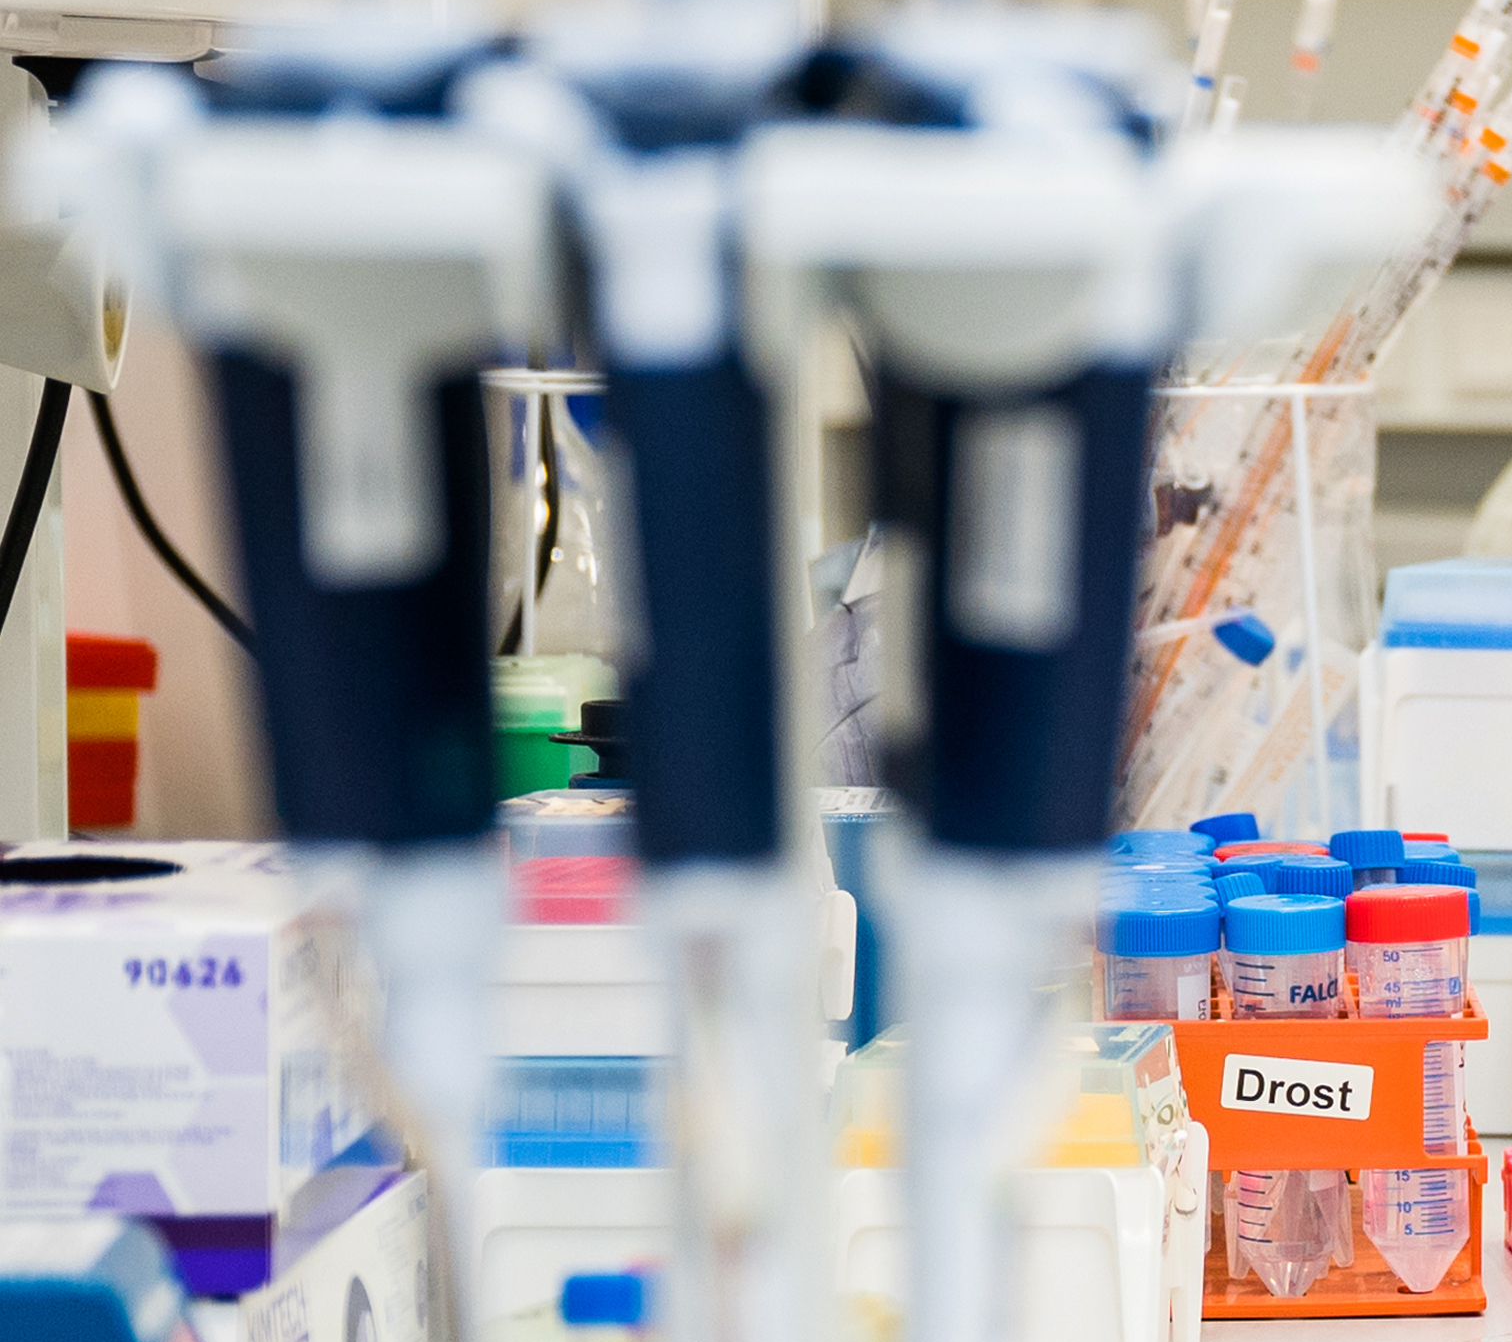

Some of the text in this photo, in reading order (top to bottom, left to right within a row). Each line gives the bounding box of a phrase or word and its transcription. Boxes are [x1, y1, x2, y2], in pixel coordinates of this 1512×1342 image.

[1383, 950, 1400, 962] 50
[124, 957, 243, 988] 90626
[1384, 981, 1401, 994] 45
[1235, 1067, 1353, 1112] Drost
[1395, 1170, 1411, 1182] 15
[1397, 1201, 1412, 1214] 10
[1404, 1223, 1413, 1236] 5
